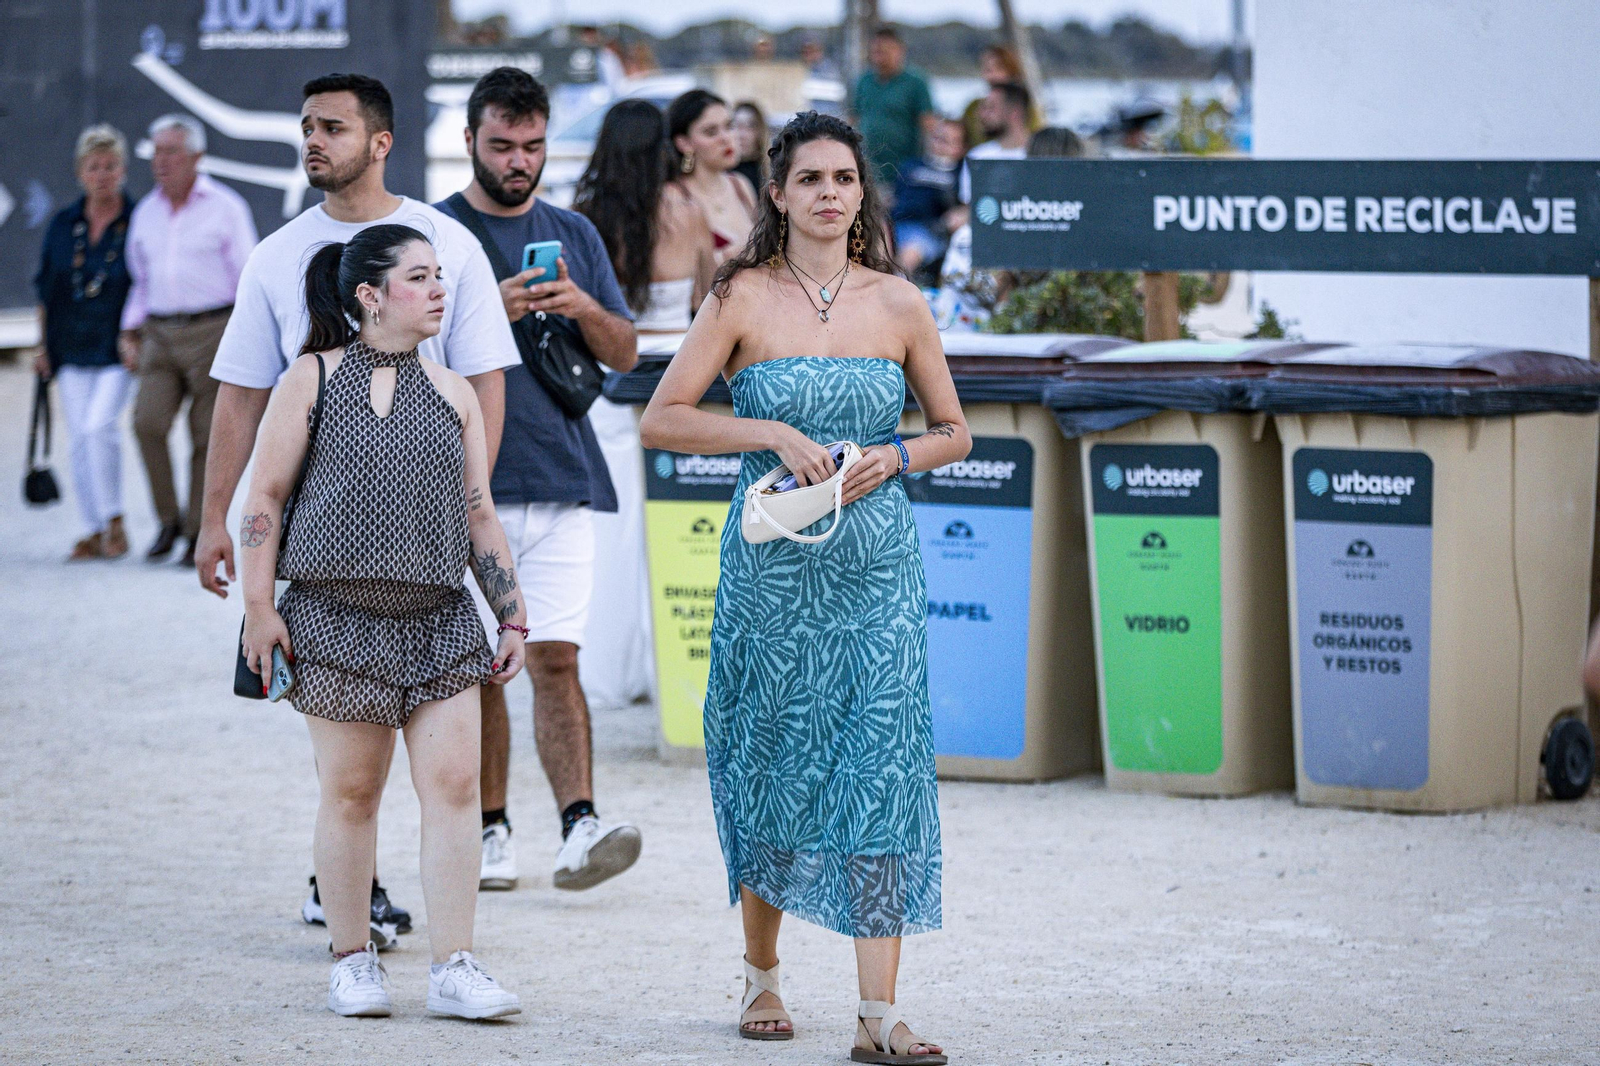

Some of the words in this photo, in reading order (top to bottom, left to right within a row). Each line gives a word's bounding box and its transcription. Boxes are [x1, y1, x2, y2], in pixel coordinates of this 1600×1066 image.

[1001, 195, 1083, 220] urbaser
[1153, 195, 1288, 232] PUNTO
[1295, 196, 1348, 232] DE
[1355, 196, 1577, 233] RECICLAJE
[675, 455, 741, 476] urbase
[1125, 463, 1203, 488] urbaser
[1332, 469, 1415, 496] urbaser
[927, 601, 992, 622] PAPEL
[1320, 610, 1404, 631] RESIDUOS
[1123, 614, 1190, 634] VIDRIO
[1312, 632, 1412, 653] ORGÁNICOS
[1322, 655, 1333, 671] Y
[1336, 656, 1401, 674] RESTOS
